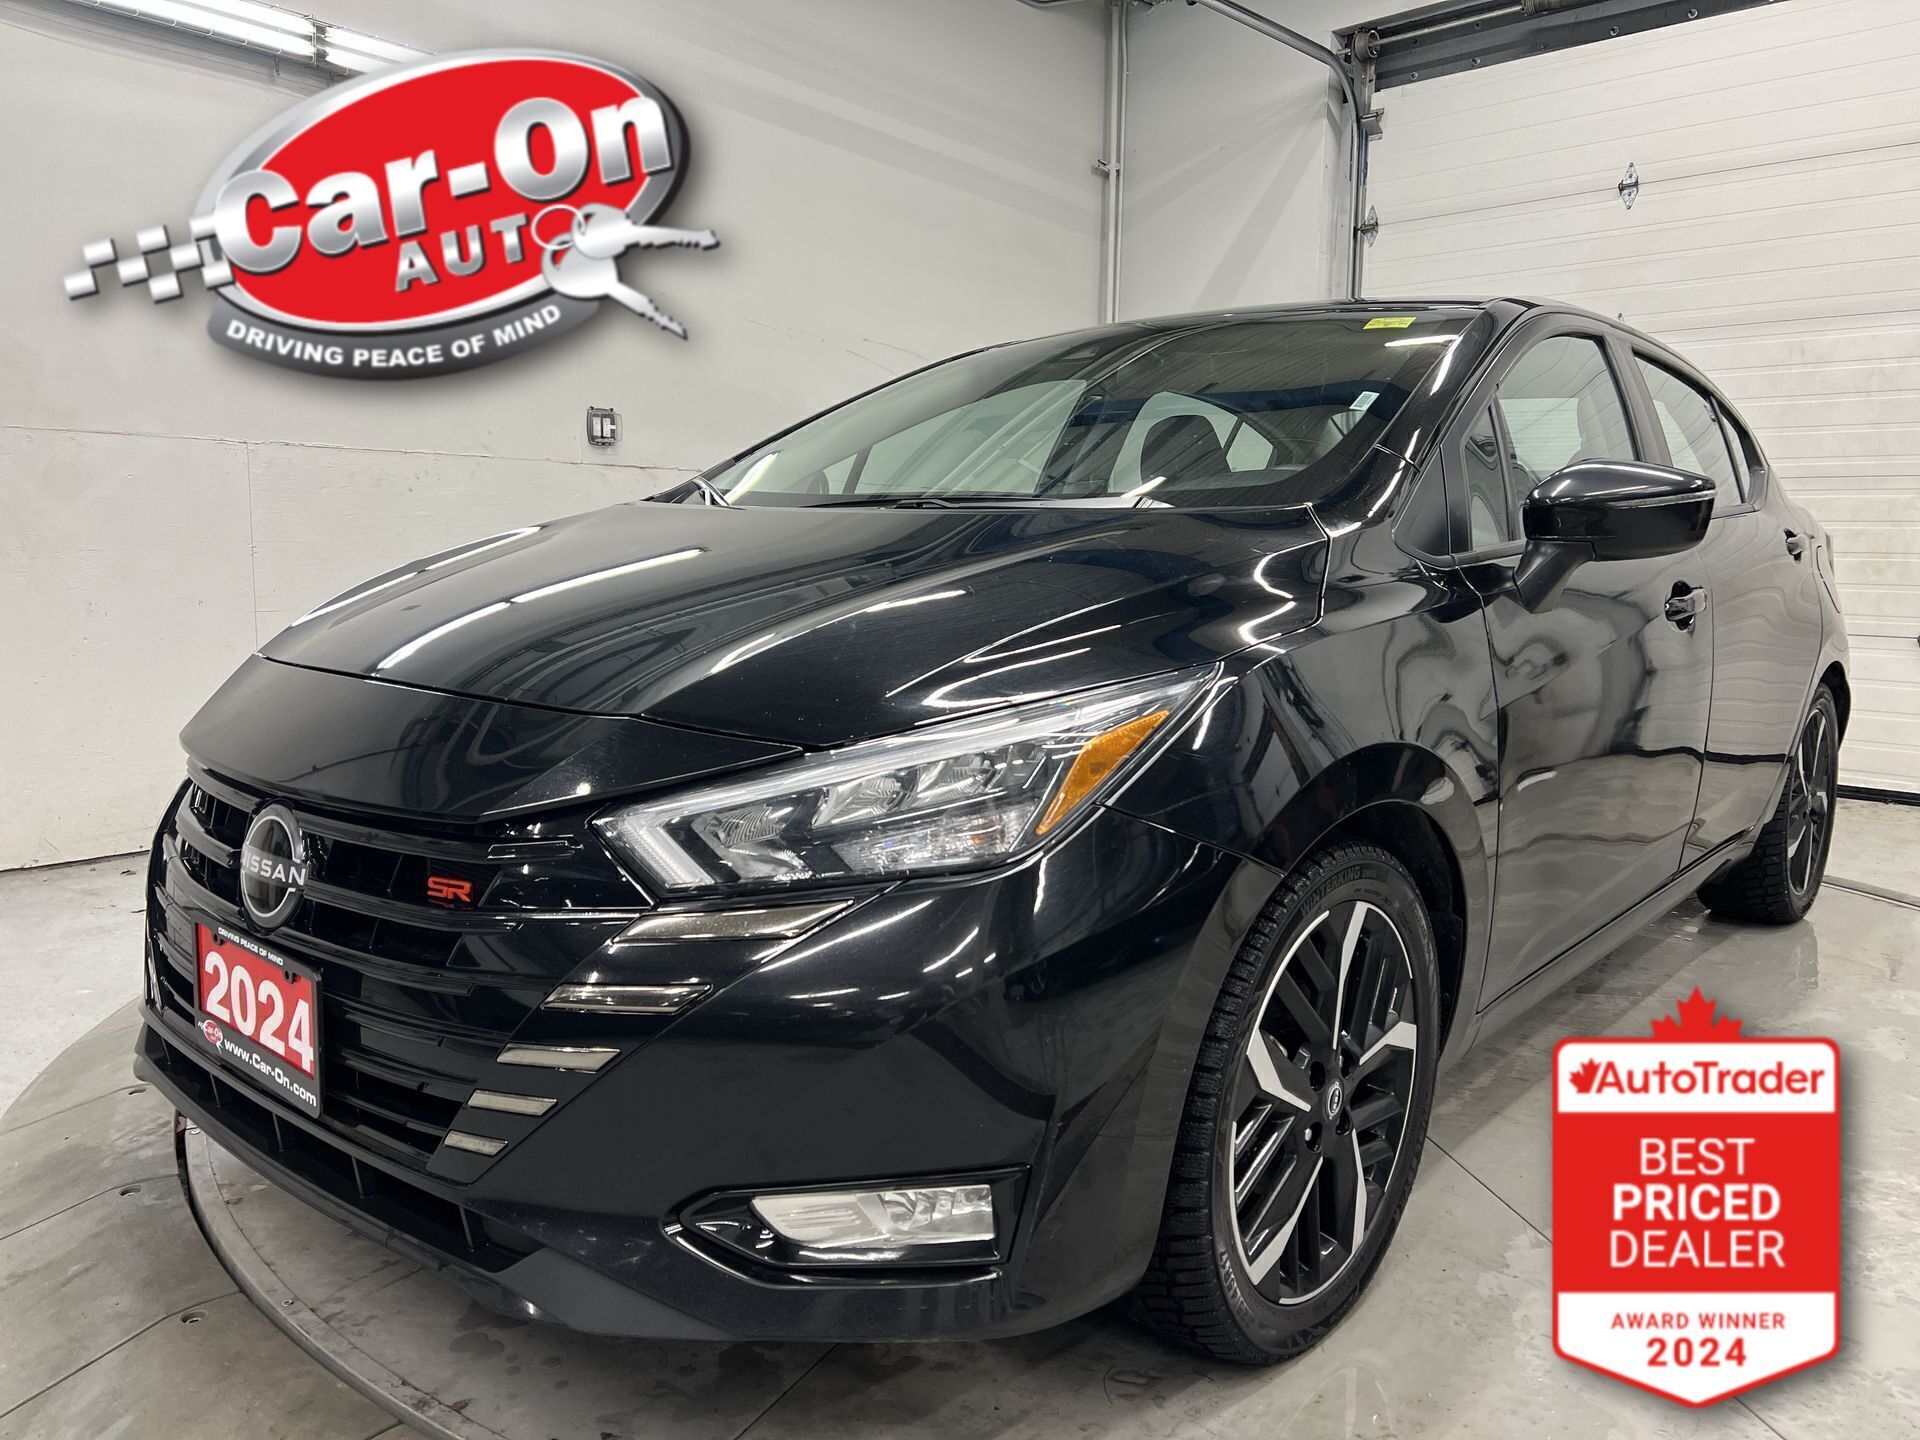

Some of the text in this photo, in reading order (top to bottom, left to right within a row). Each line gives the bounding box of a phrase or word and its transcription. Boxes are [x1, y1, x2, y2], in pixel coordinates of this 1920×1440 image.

[242, 848, 306, 886] ISSAN
[427, 876, 472, 902] SR
[204, 951, 314, 1073] 2024
[224, 1039, 317, 1107] www.Car-On.com
